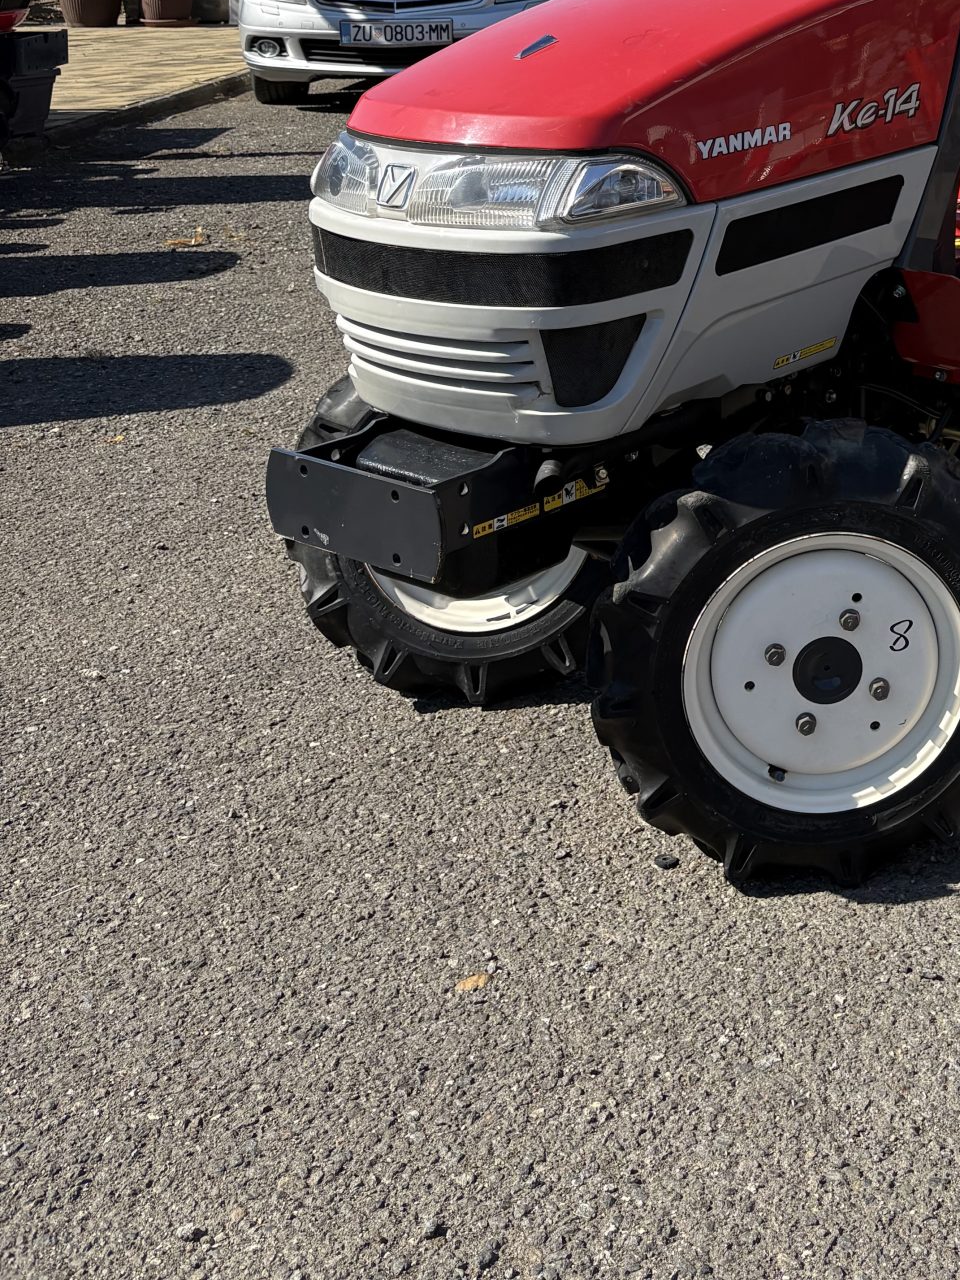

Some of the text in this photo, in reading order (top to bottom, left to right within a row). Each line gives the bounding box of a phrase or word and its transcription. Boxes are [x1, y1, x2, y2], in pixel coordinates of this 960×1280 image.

[352, 25, 372, 42] ZU
[697, 83, 920, 160] YANMAR Ke-14
[889, 619, 914, 652] 8
